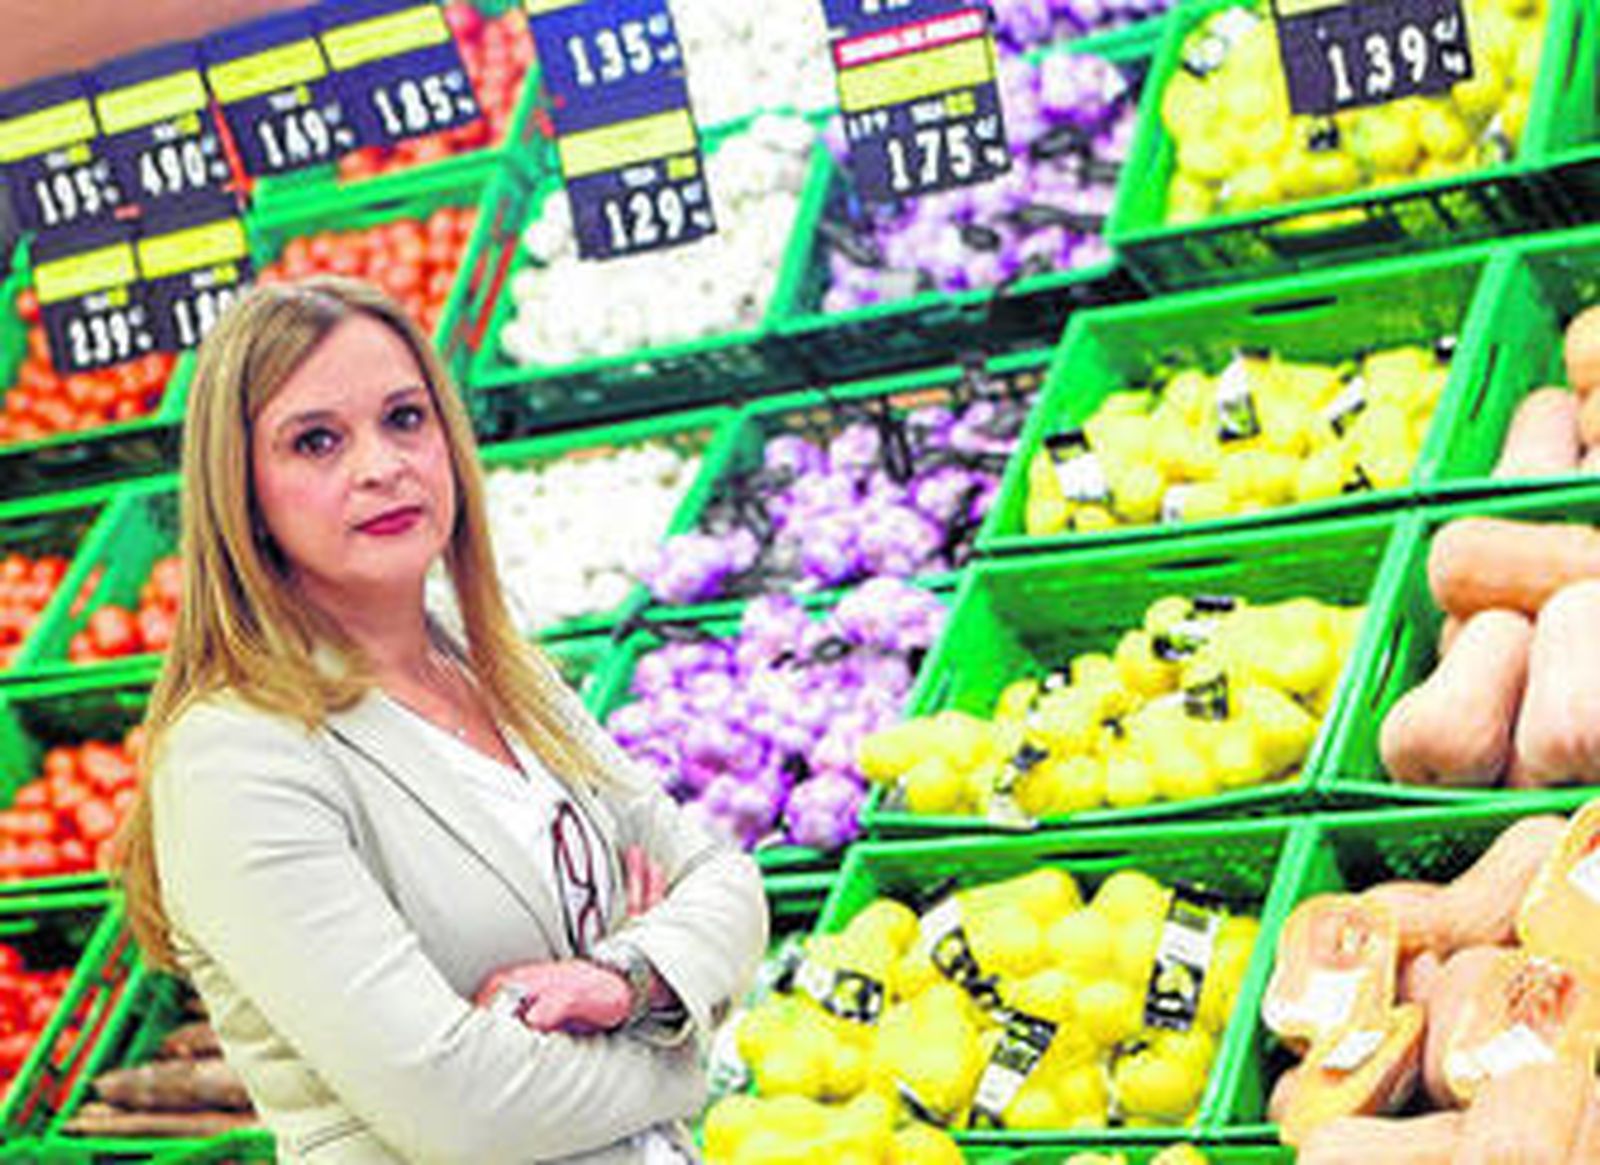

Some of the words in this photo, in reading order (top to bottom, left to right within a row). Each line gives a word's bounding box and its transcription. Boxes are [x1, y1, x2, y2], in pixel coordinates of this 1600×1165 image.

[568, 20, 653, 87] 135
[1328, 24, 1427, 104] 139
[373, 75, 453, 135] 185
[887, 124, 972, 191] 175
[36, 166, 101, 226] 195
[604, 187, 685, 249] 129
